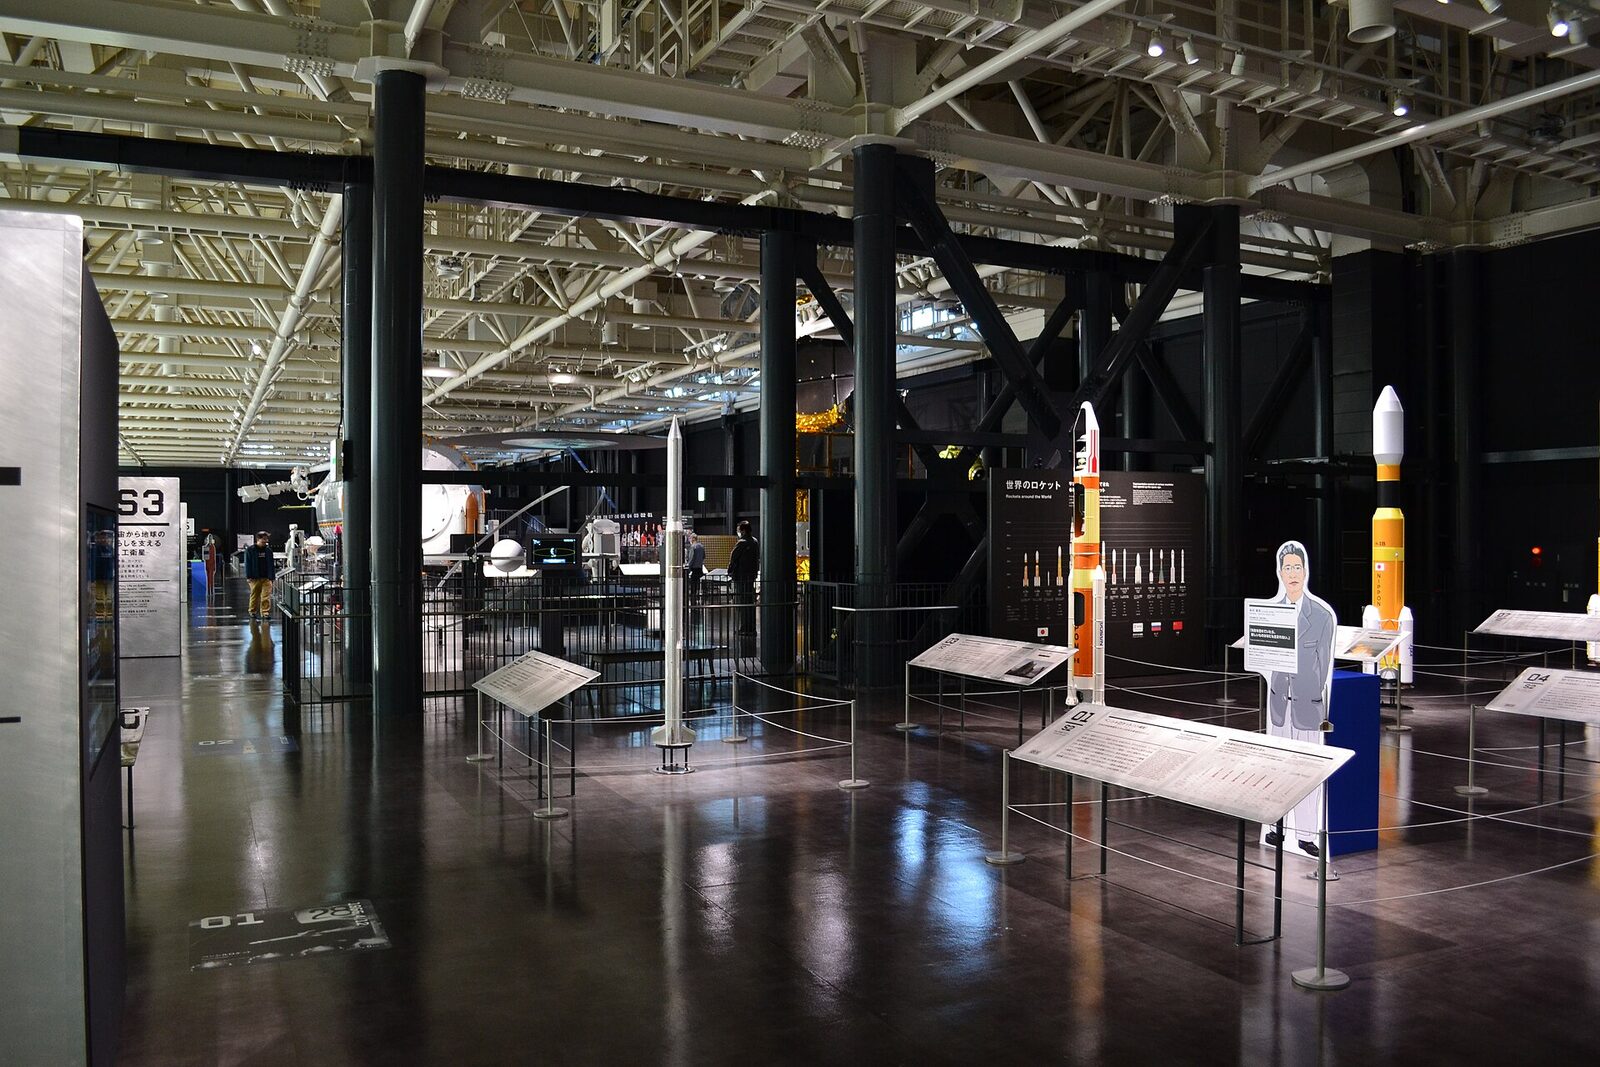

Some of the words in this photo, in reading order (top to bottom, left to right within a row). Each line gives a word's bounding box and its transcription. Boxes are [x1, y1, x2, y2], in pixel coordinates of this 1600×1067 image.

[1005, 479, 1062, 491] 世界のロケット
[118, 489, 164, 516] S3
[1527, 673, 1551, 682] 04
[1070, 711, 1095, 722] 01
[1061, 724, 1076, 732] S2
[309, 906, 352, 920] 28
[200, 912, 264, 929] 01
